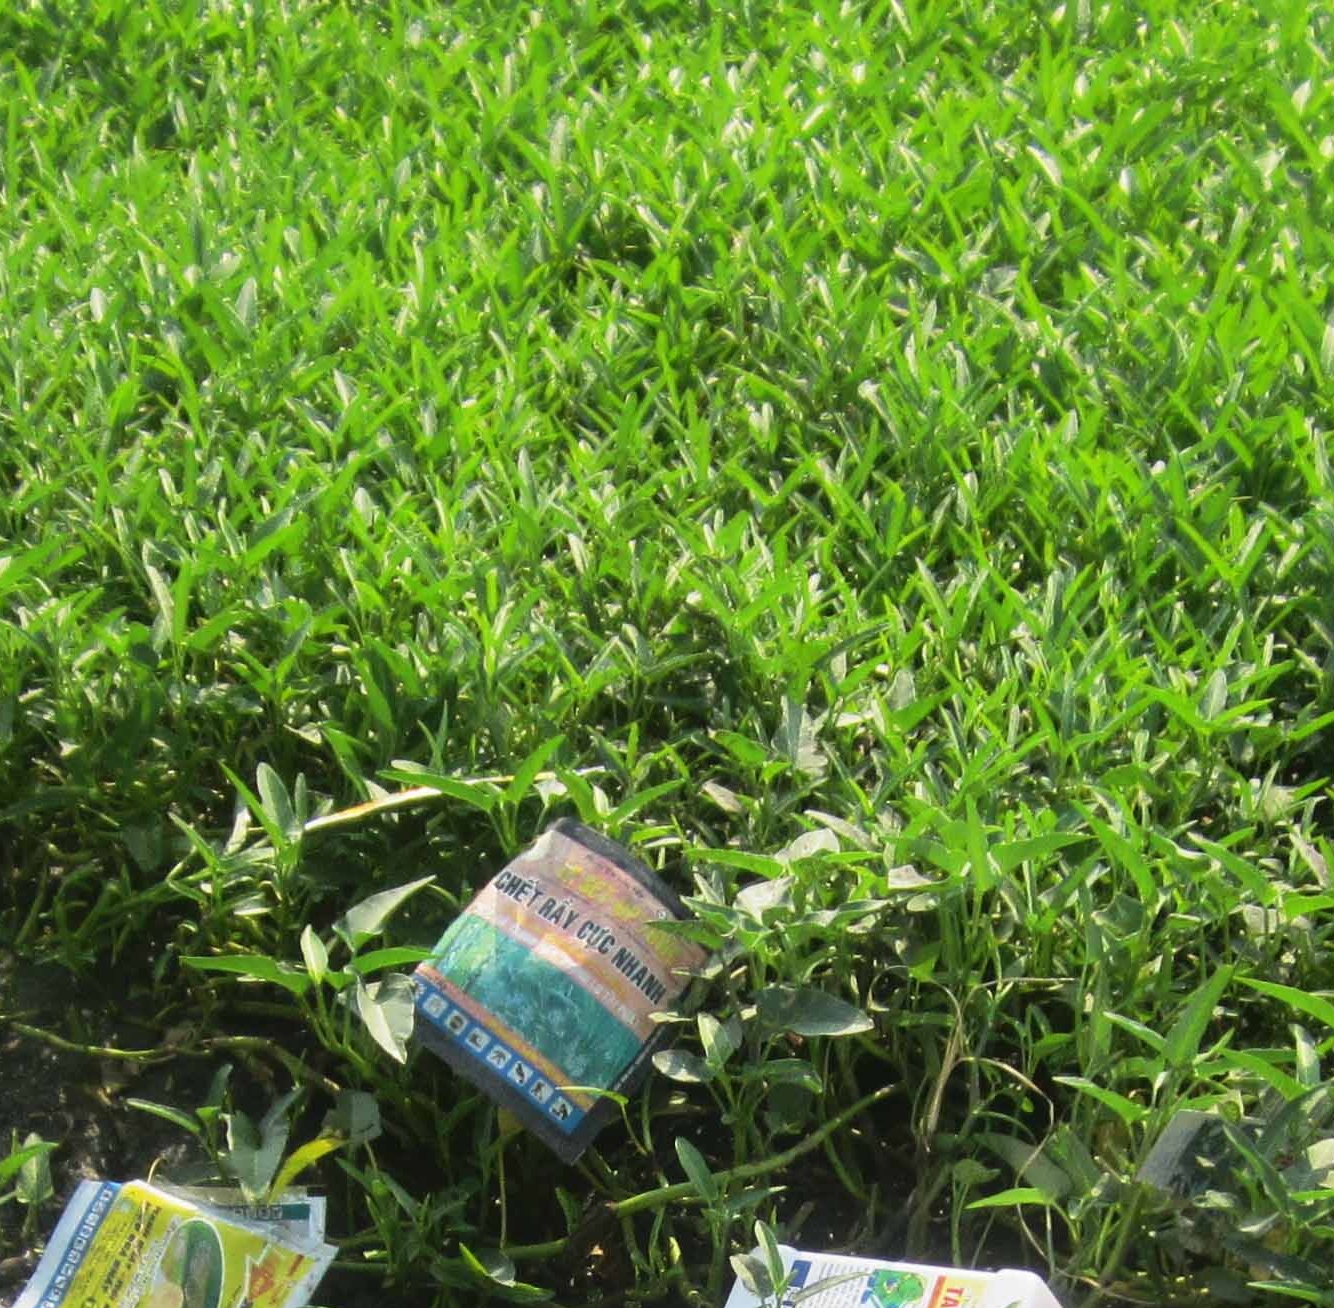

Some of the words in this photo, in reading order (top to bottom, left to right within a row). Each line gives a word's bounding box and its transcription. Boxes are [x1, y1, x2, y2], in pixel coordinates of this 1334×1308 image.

[495, 870, 541, 908] CHẾT
[577, 917, 615, 953] CỰC
[612, 946, 667, 1005] NHANH
